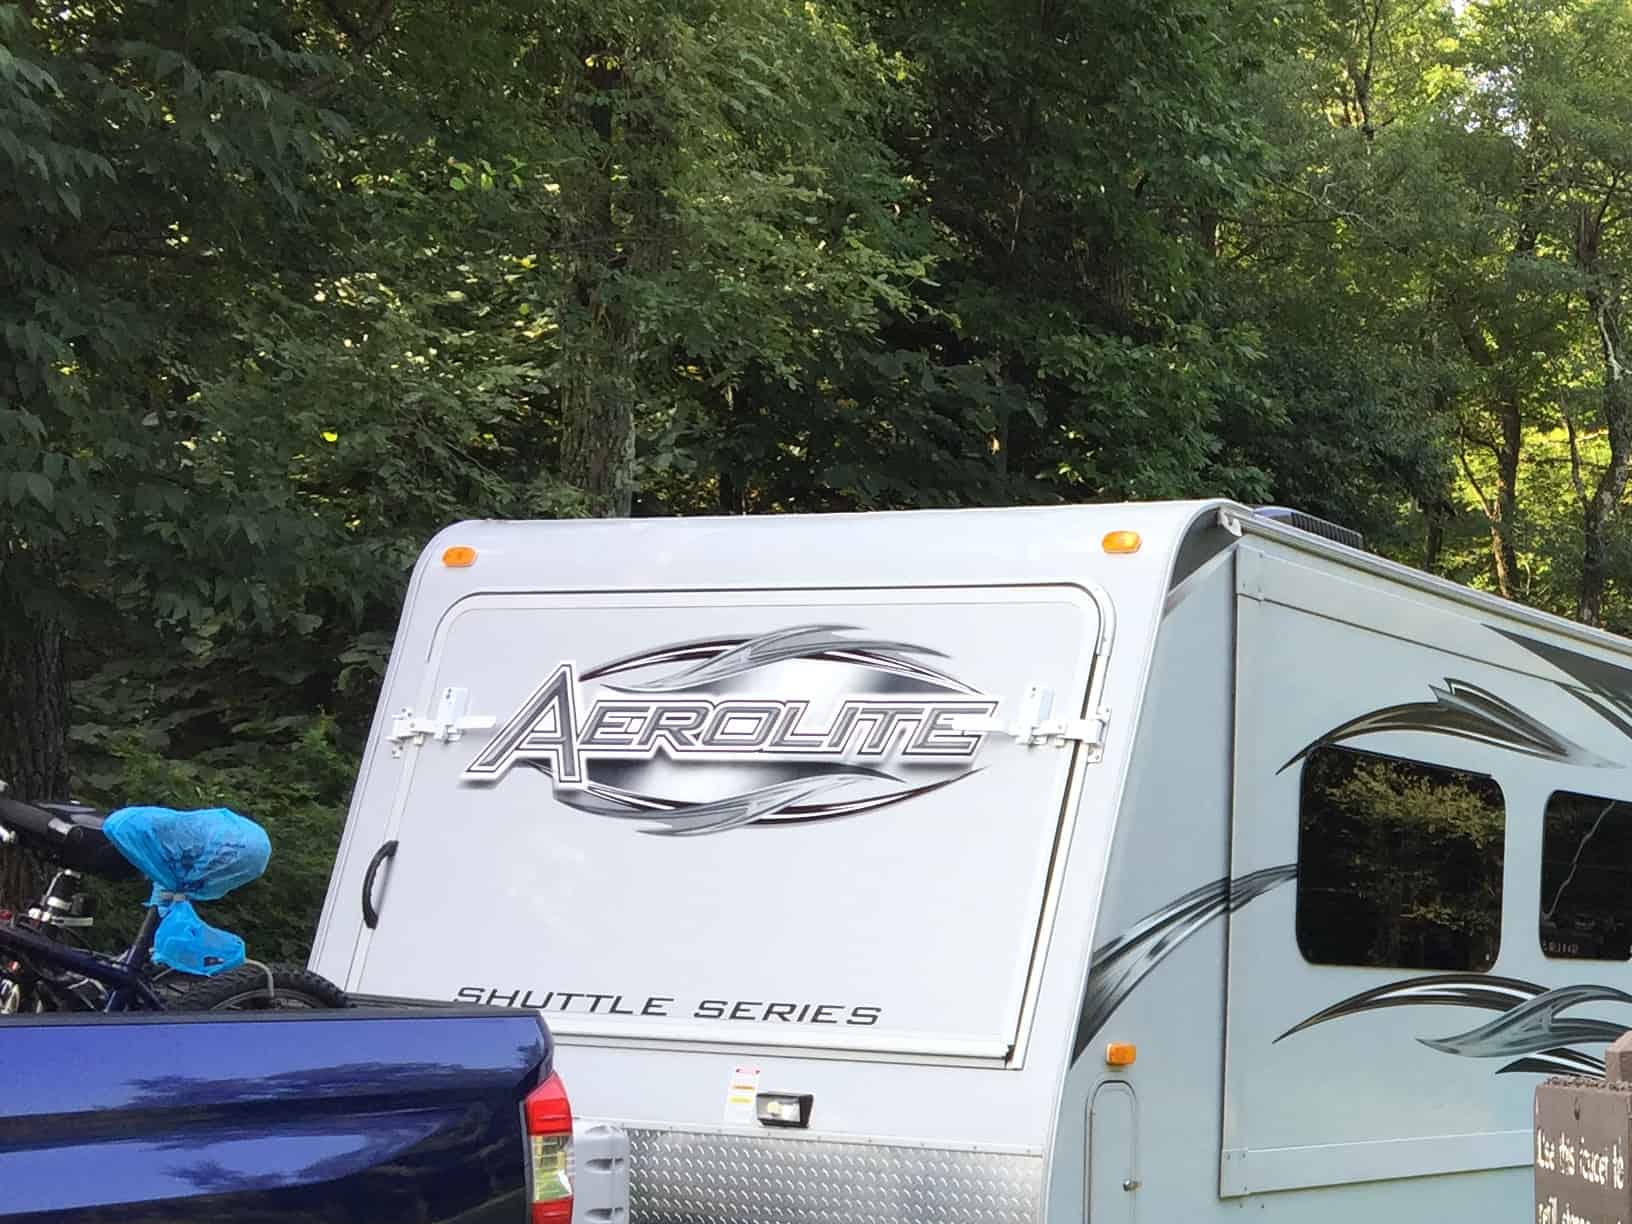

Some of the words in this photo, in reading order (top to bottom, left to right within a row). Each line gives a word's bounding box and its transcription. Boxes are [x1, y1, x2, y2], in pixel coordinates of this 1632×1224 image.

[463, 661, 999, 785] AEROLITE
[455, 986, 675, 1017] SHUTTLE
[694, 1000, 882, 1026] SERIES
